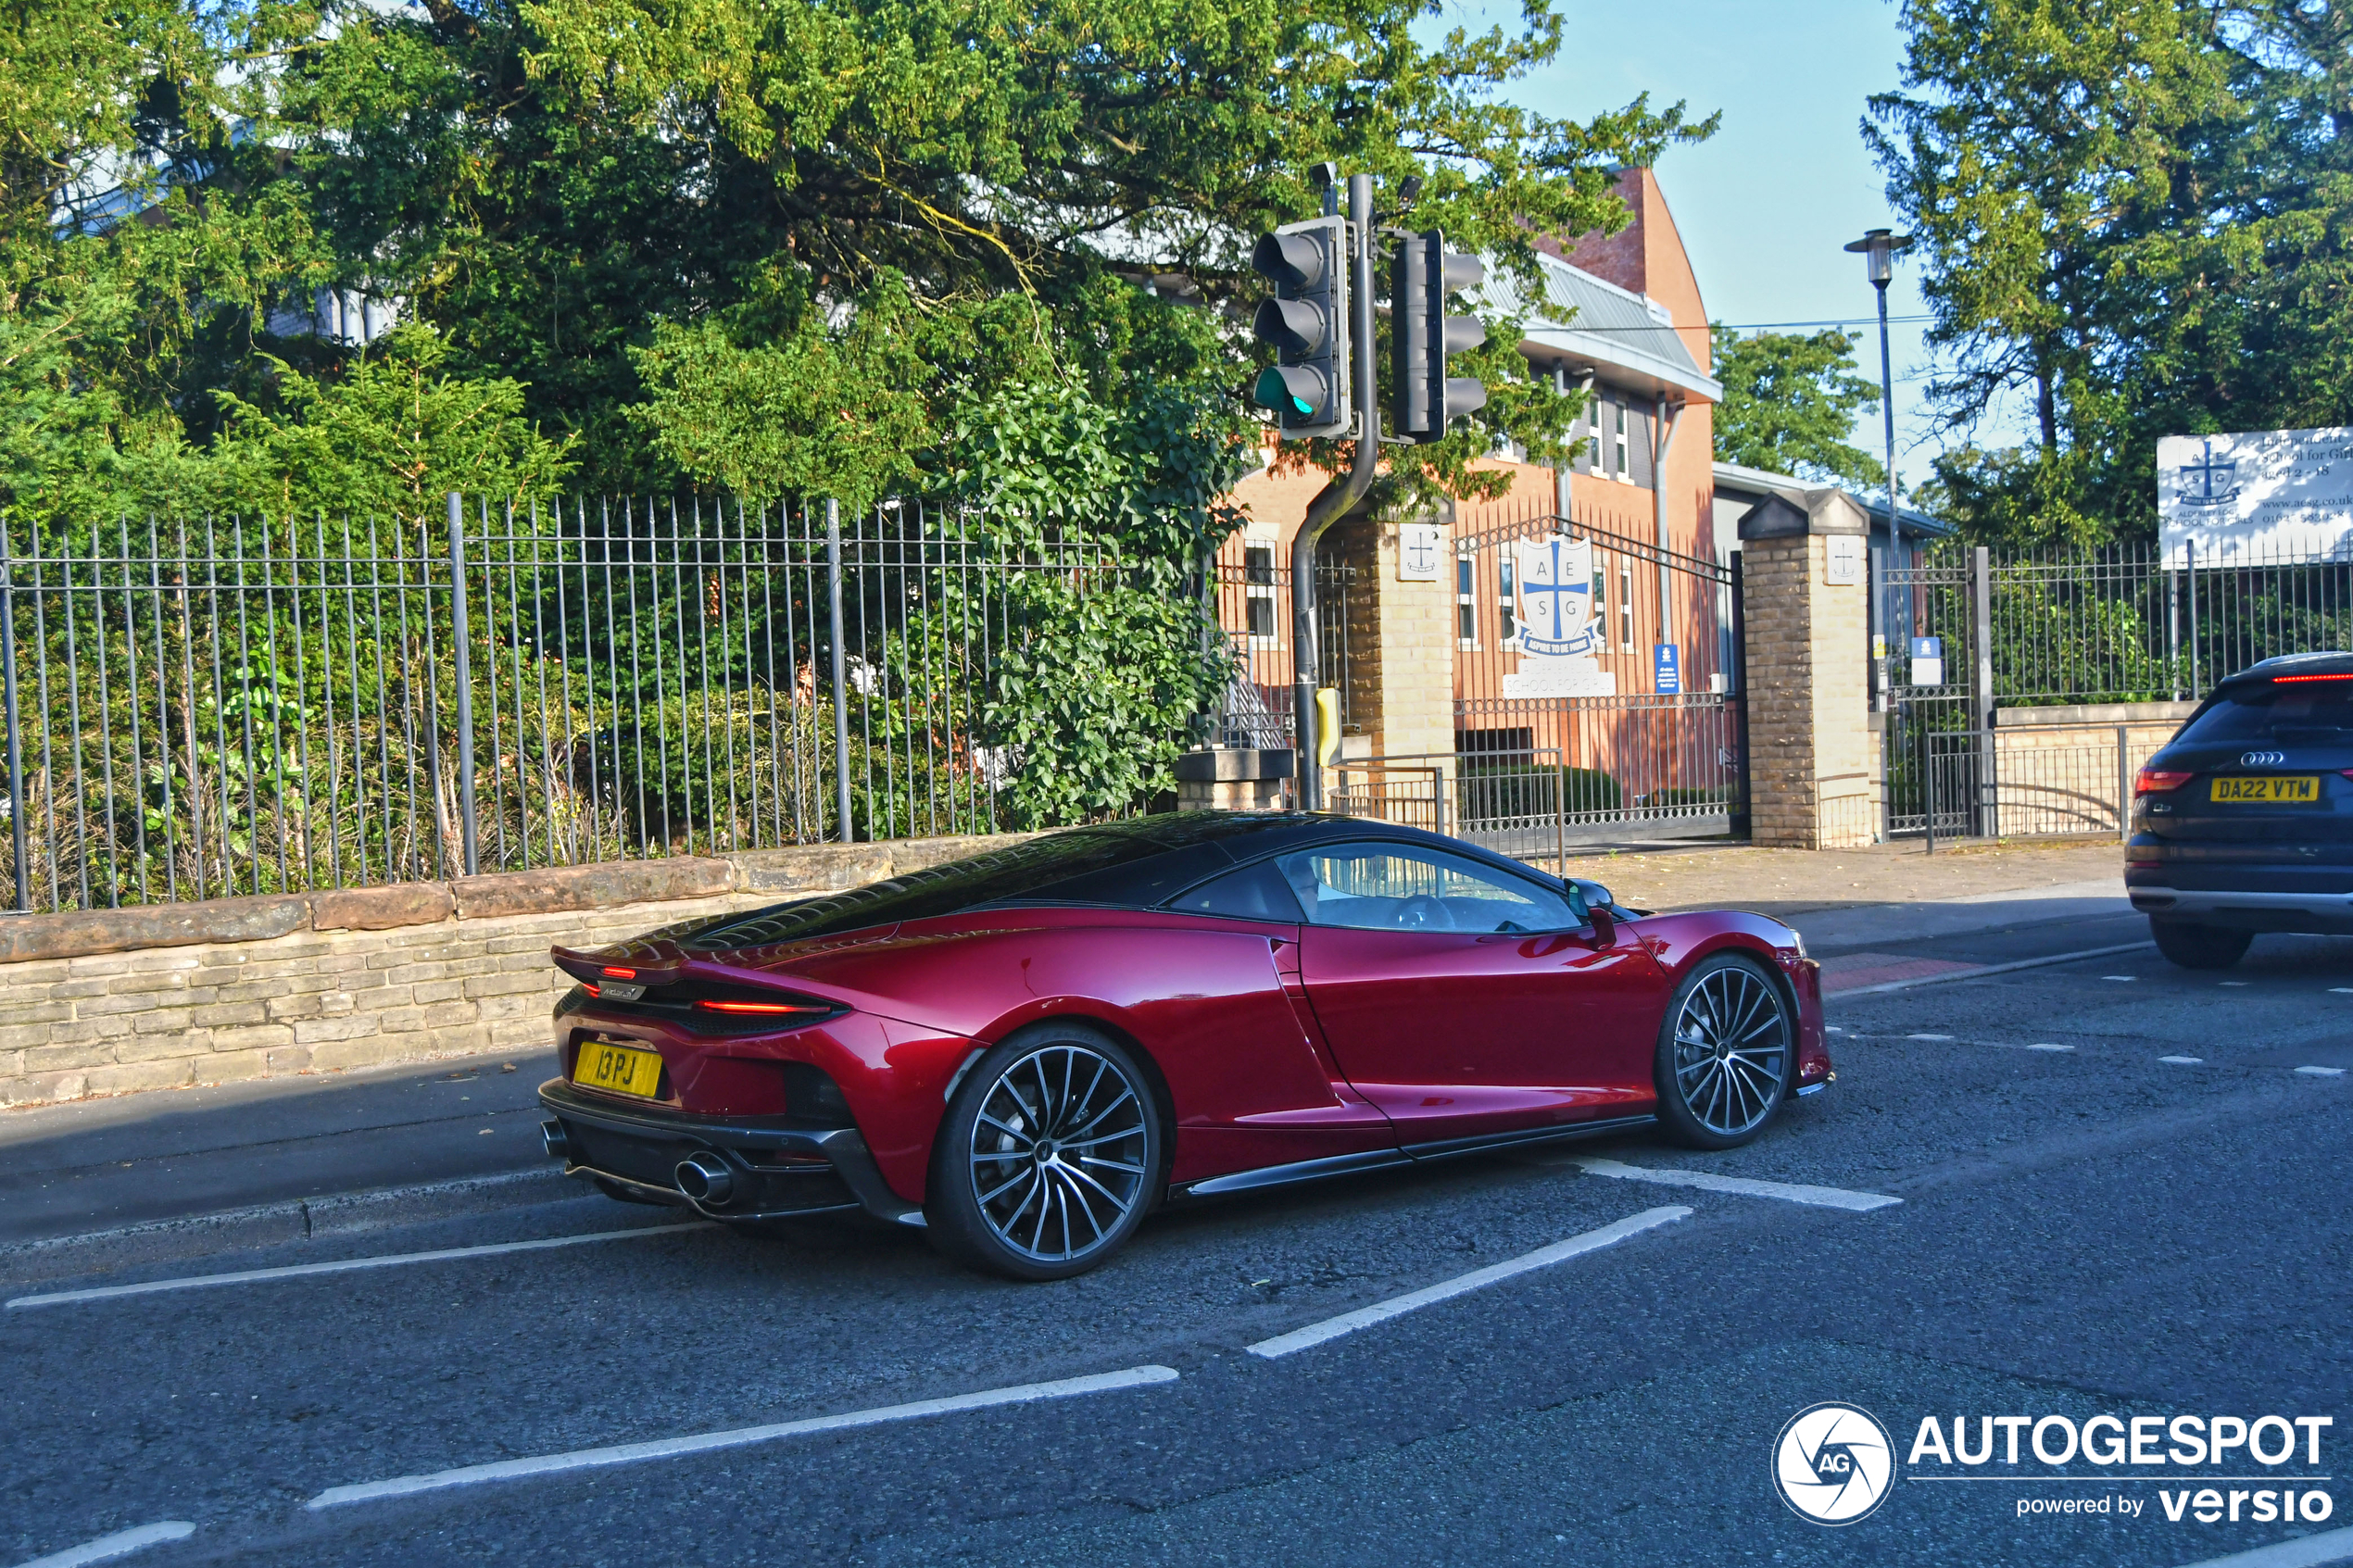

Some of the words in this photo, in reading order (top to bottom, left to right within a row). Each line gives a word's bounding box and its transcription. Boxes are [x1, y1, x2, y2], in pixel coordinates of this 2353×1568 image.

[2191, 454, 2201, 462] A
[2215, 452, 2223, 461] E
[2262, 450, 2303, 463] School
[2308, 449, 2326, 461] for
[2191, 474, 2200, 484] S
[2215, 473, 2225, 483] G
[2261, 467, 2291, 481] aged
[2294, 469, 2302, 478] 2
[2316, 465, 2330, 476] 18
[2262, 495, 2353, 508] www.aesg.co.uk
[2178, 509, 2216, 518] ALDERLEY
[2165, 518, 2204, 528] SCHOOL
[2207, 518, 2225, 526] FOR
[2227, 516, 2254, 525] GIRLS
[1536, 561, 1548, 576] A
[1566, 561, 1574, 576] E
[1538, 600, 1547, 616] S
[1566, 600, 1576, 616] G
[1506, 679, 1554, 693] SCHOOL
[1557, 678, 1578, 691] FOR
[1582, 678, 1610, 691] GRLS
[2218, 780, 2267, 799] DA22
[2273, 779, 2311, 798] VTM
[596, 1049, 636, 1085] 13PJ
